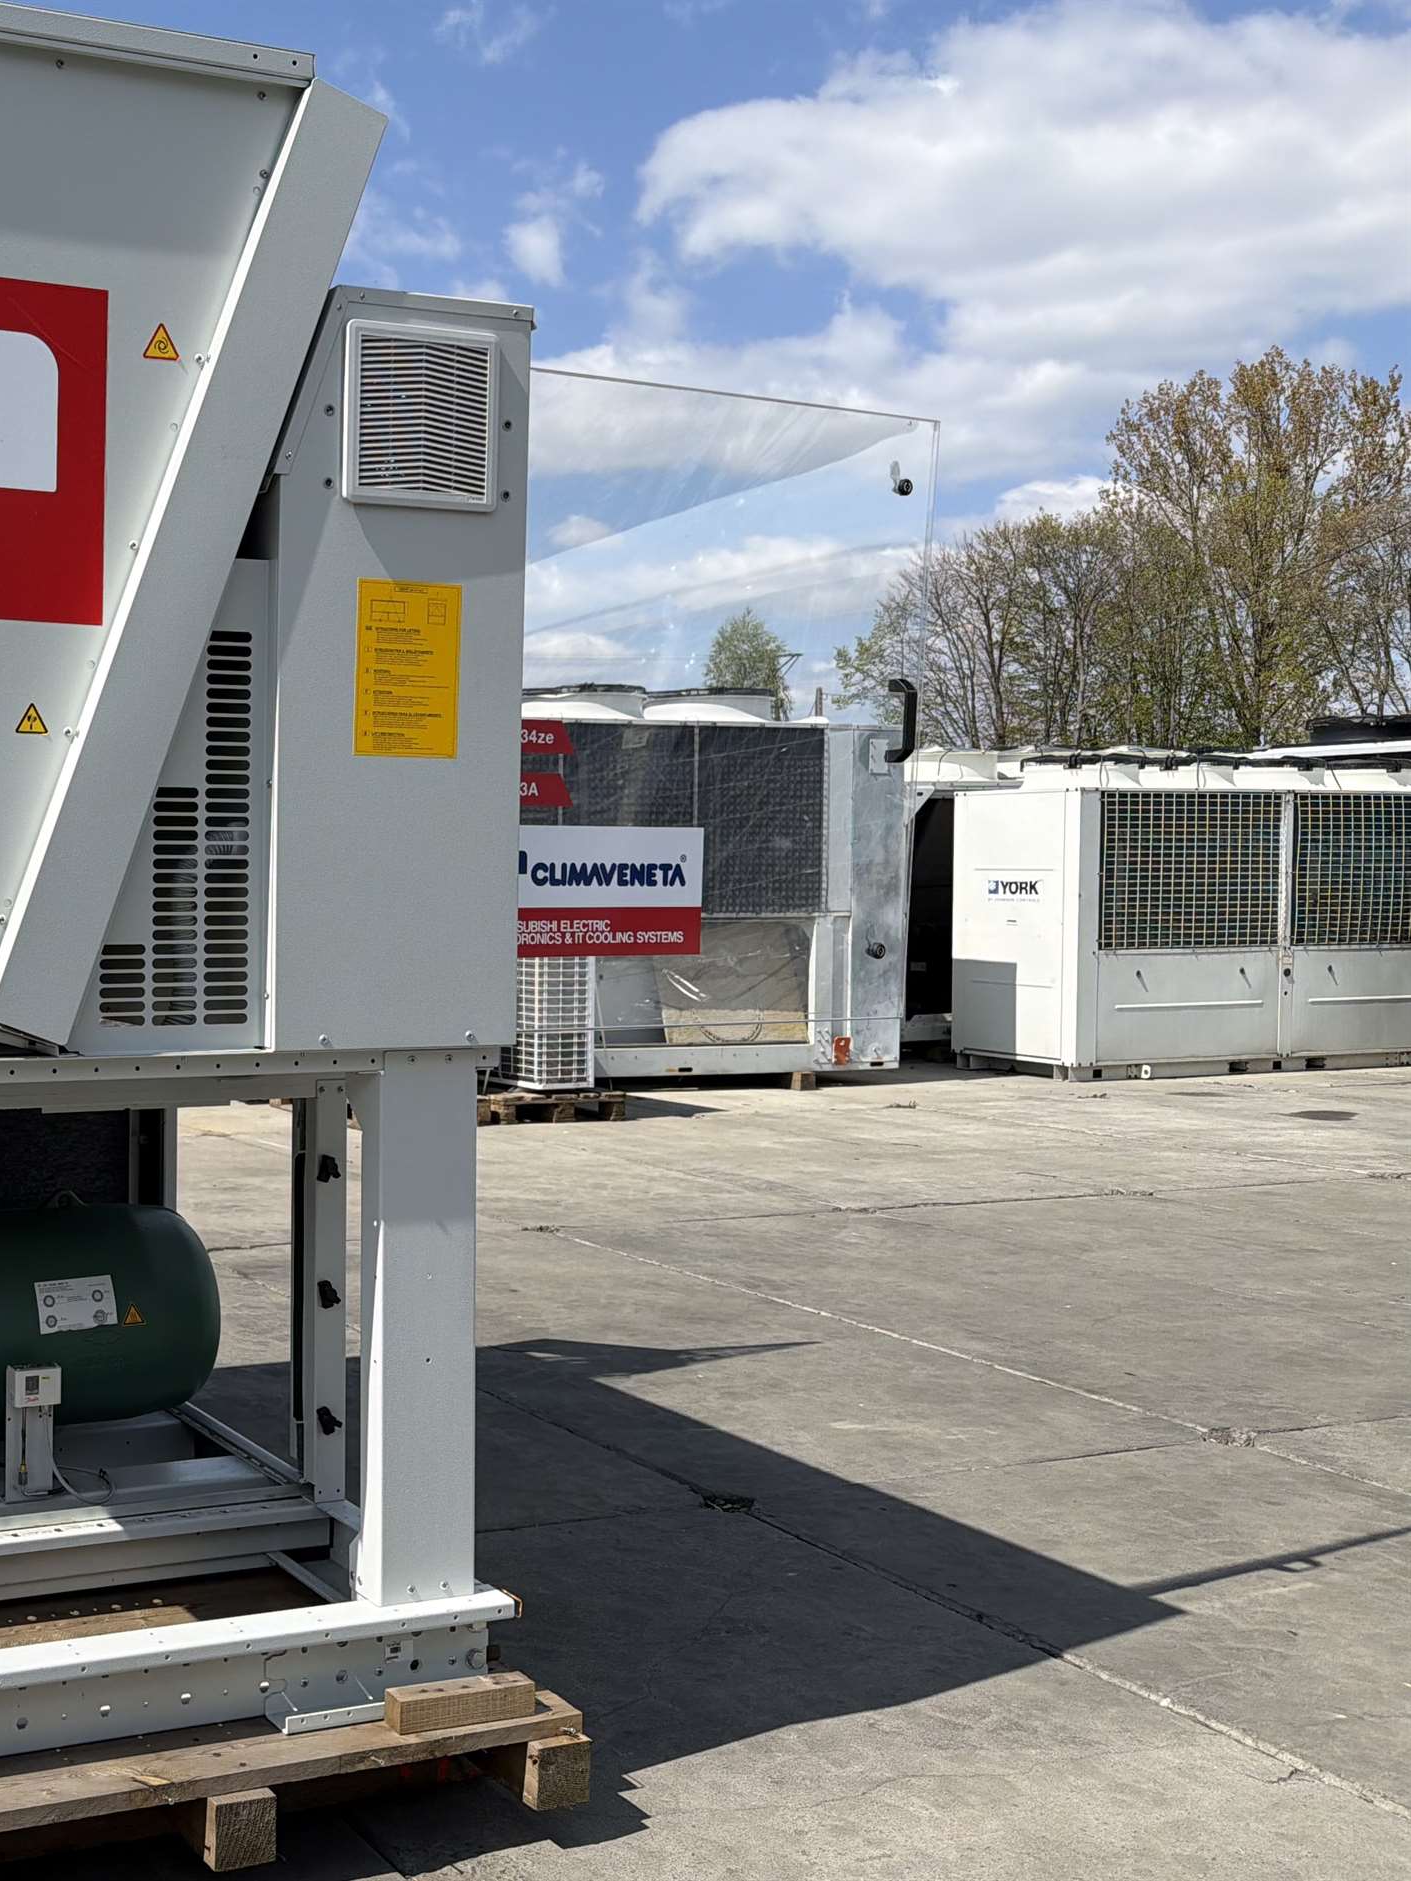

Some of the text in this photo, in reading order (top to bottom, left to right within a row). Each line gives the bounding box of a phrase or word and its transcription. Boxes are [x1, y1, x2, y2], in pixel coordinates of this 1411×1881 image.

[520, 729, 555, 744] 34ze
[1000, 881, 1039, 895] YORK
[560, 920, 611, 932] ELECTRIC
[564, 932, 573, 944] &
[574, 932, 584, 944] IT
[585, 932, 634, 944] COOLING
[636, 931, 684, 943] SYSTEMS
